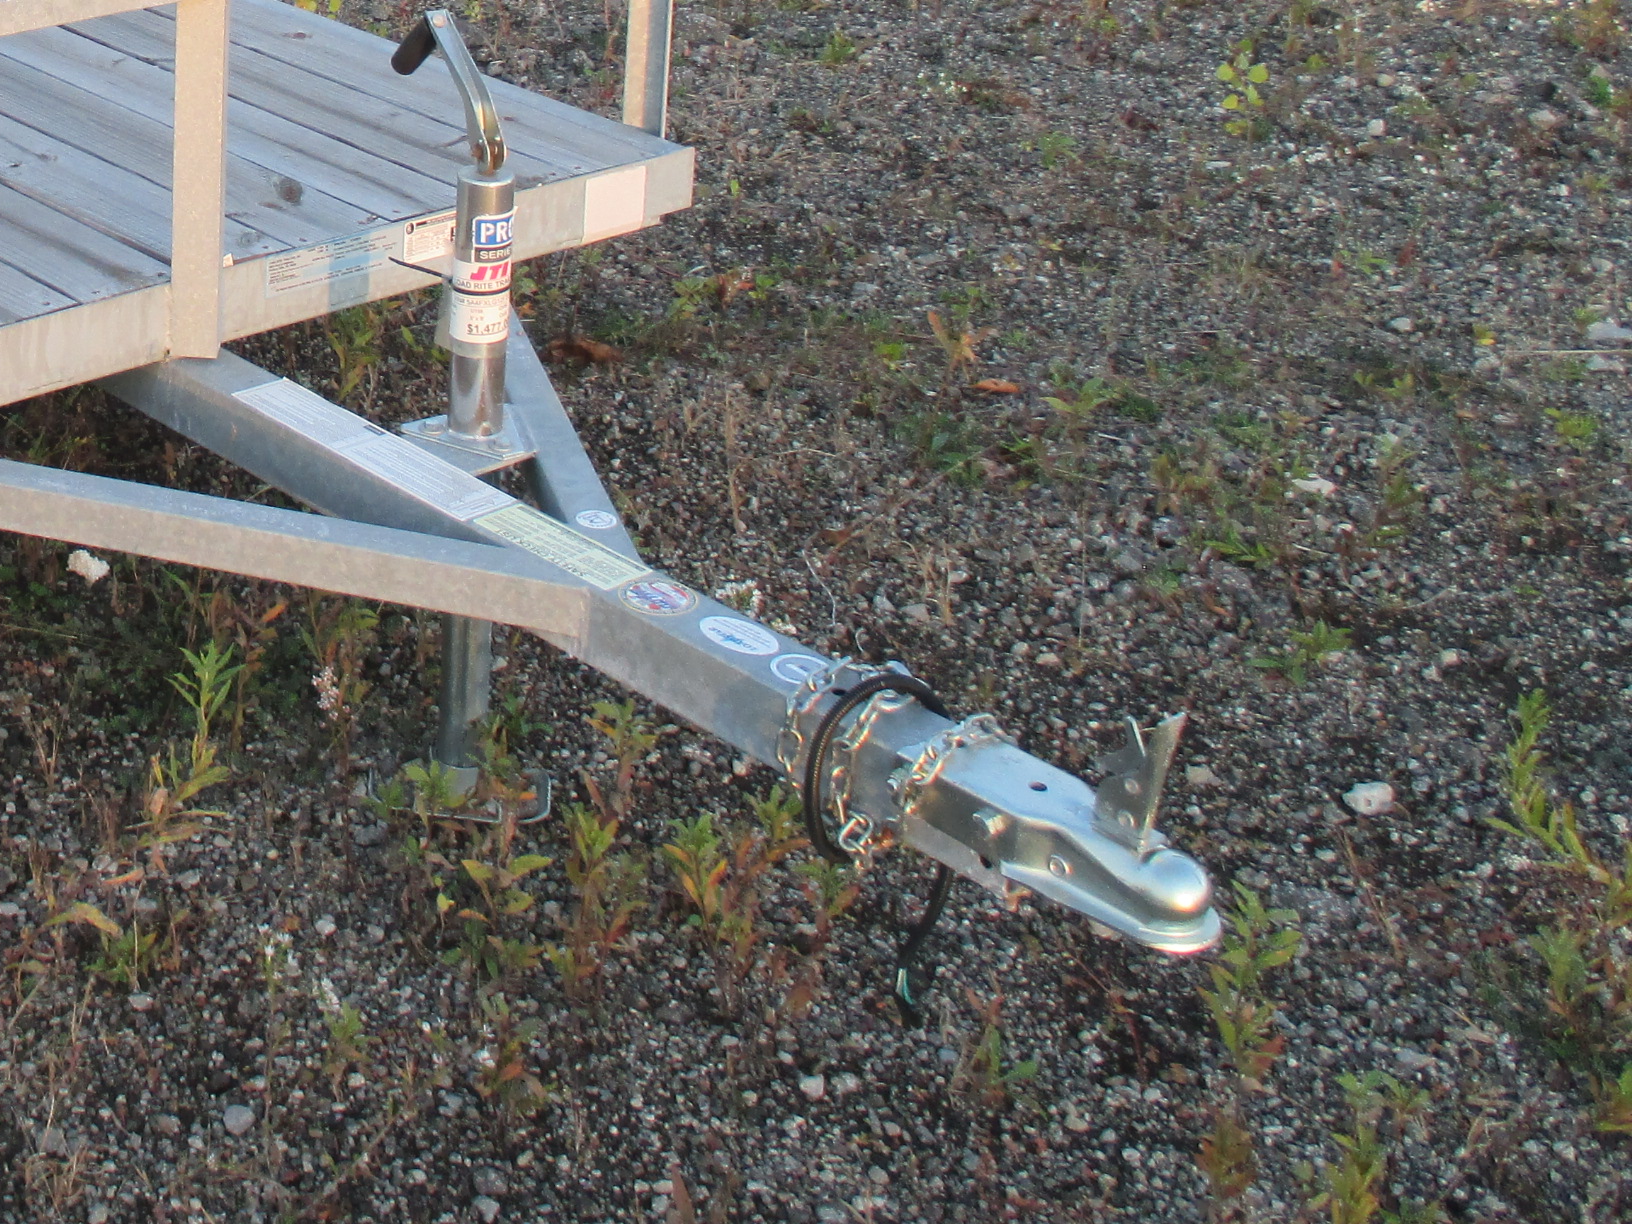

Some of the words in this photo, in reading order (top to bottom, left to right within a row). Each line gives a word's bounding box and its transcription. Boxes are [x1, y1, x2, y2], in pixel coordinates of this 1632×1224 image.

[479, 248, 511, 260] SERIE
[455, 278, 472, 290] OAD
[473, 280, 493, 290] RITE
[466, 319, 508, 336] $1,477.0
